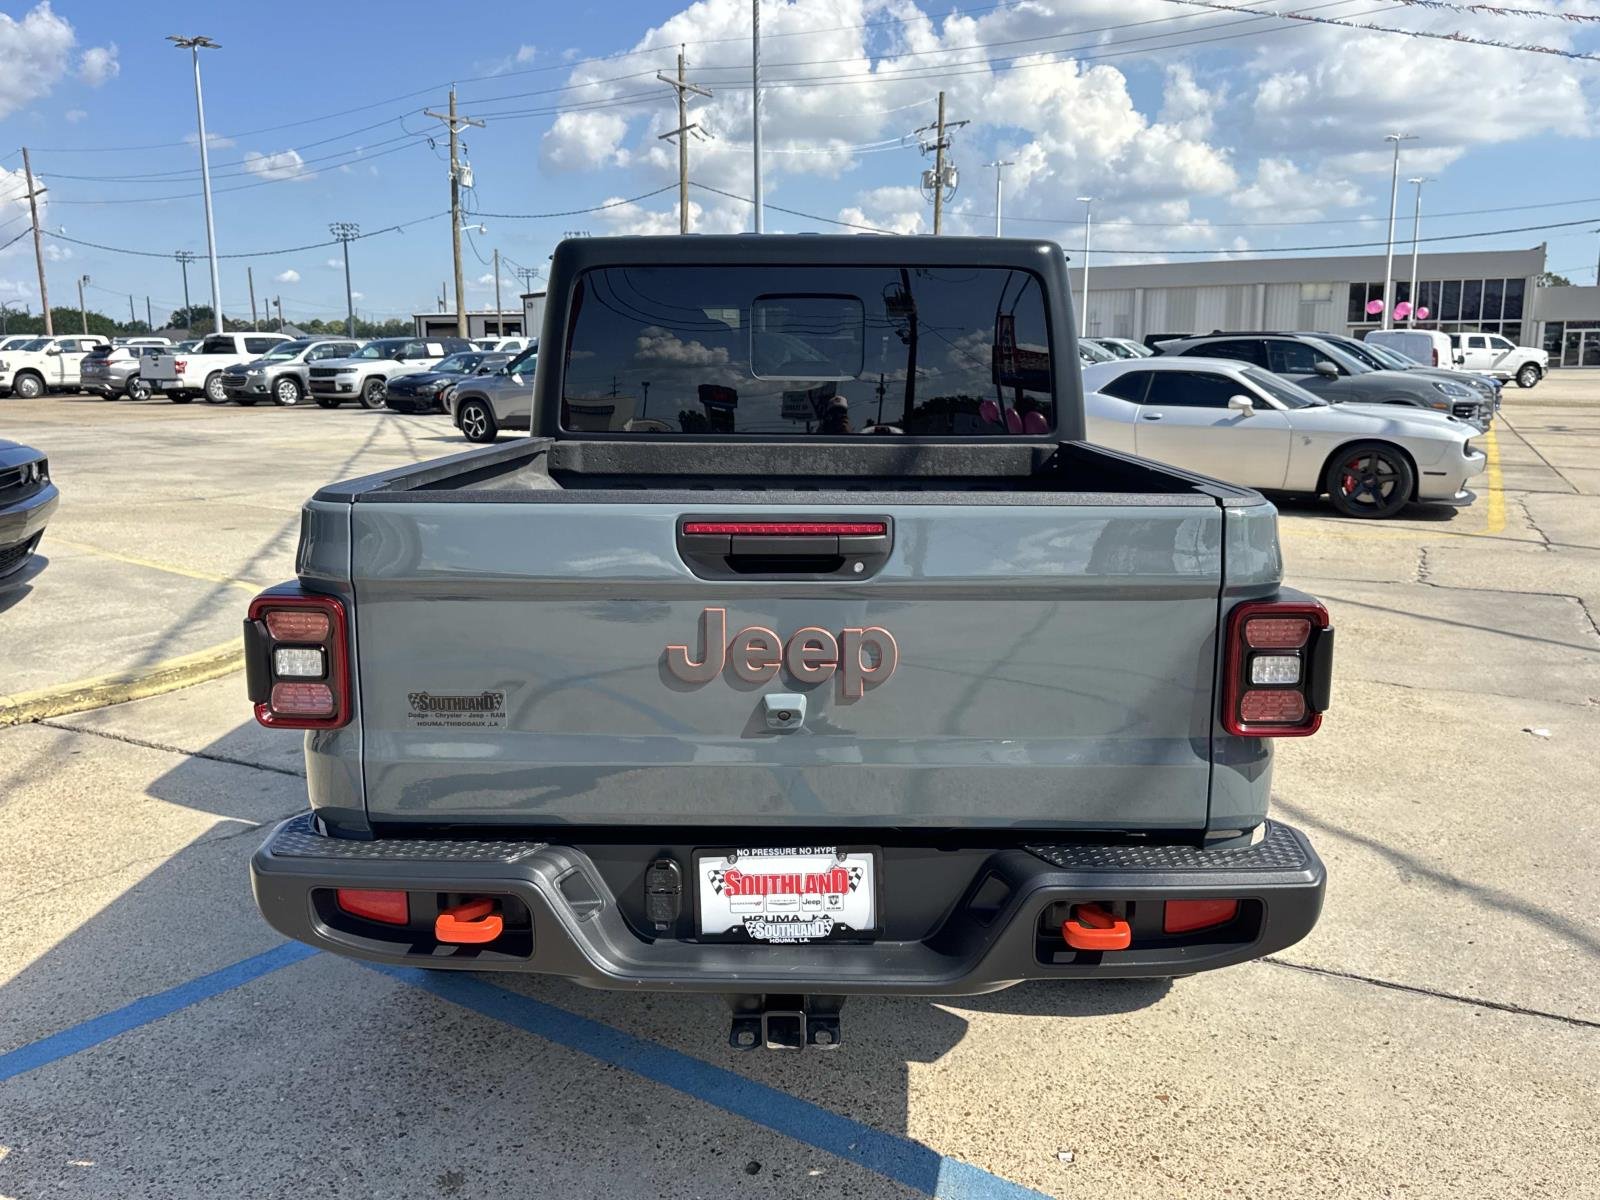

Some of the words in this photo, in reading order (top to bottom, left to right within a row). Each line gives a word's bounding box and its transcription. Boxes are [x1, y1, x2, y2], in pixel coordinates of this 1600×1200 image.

[665, 607, 898, 697] Jeep
[419, 694, 495, 711] SOUTHLAND
[736, 849, 750, 857] NO
[751, 847, 797, 856] PRESSURE
[799, 847, 812, 855] NO
[814, 846, 836, 854] HYPE
[724, 868, 849, 897] SOUTHLAND
[802, 898, 821, 906] Jeep
[755, 921, 826, 939] SOUTHLAND
